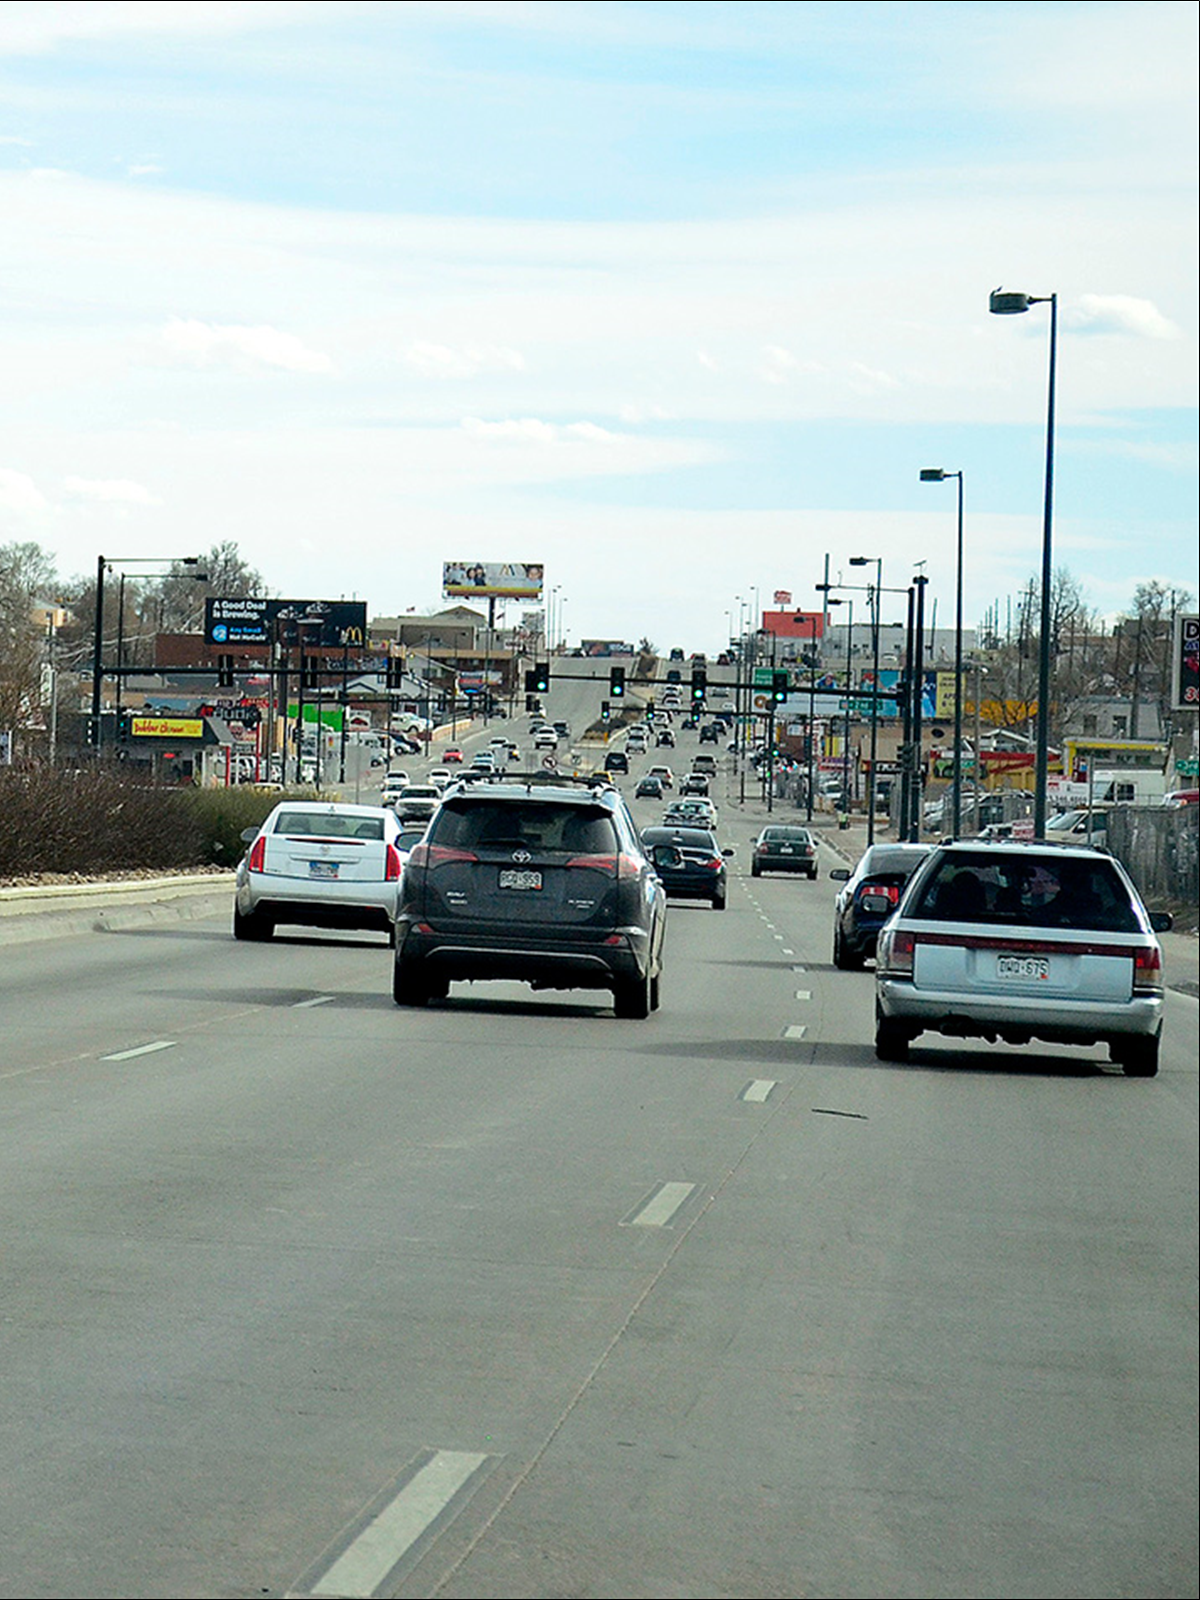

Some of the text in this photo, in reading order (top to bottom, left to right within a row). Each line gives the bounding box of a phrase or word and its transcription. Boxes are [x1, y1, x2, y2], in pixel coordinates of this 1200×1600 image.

[213, 601, 267, 611] A Good Deal
